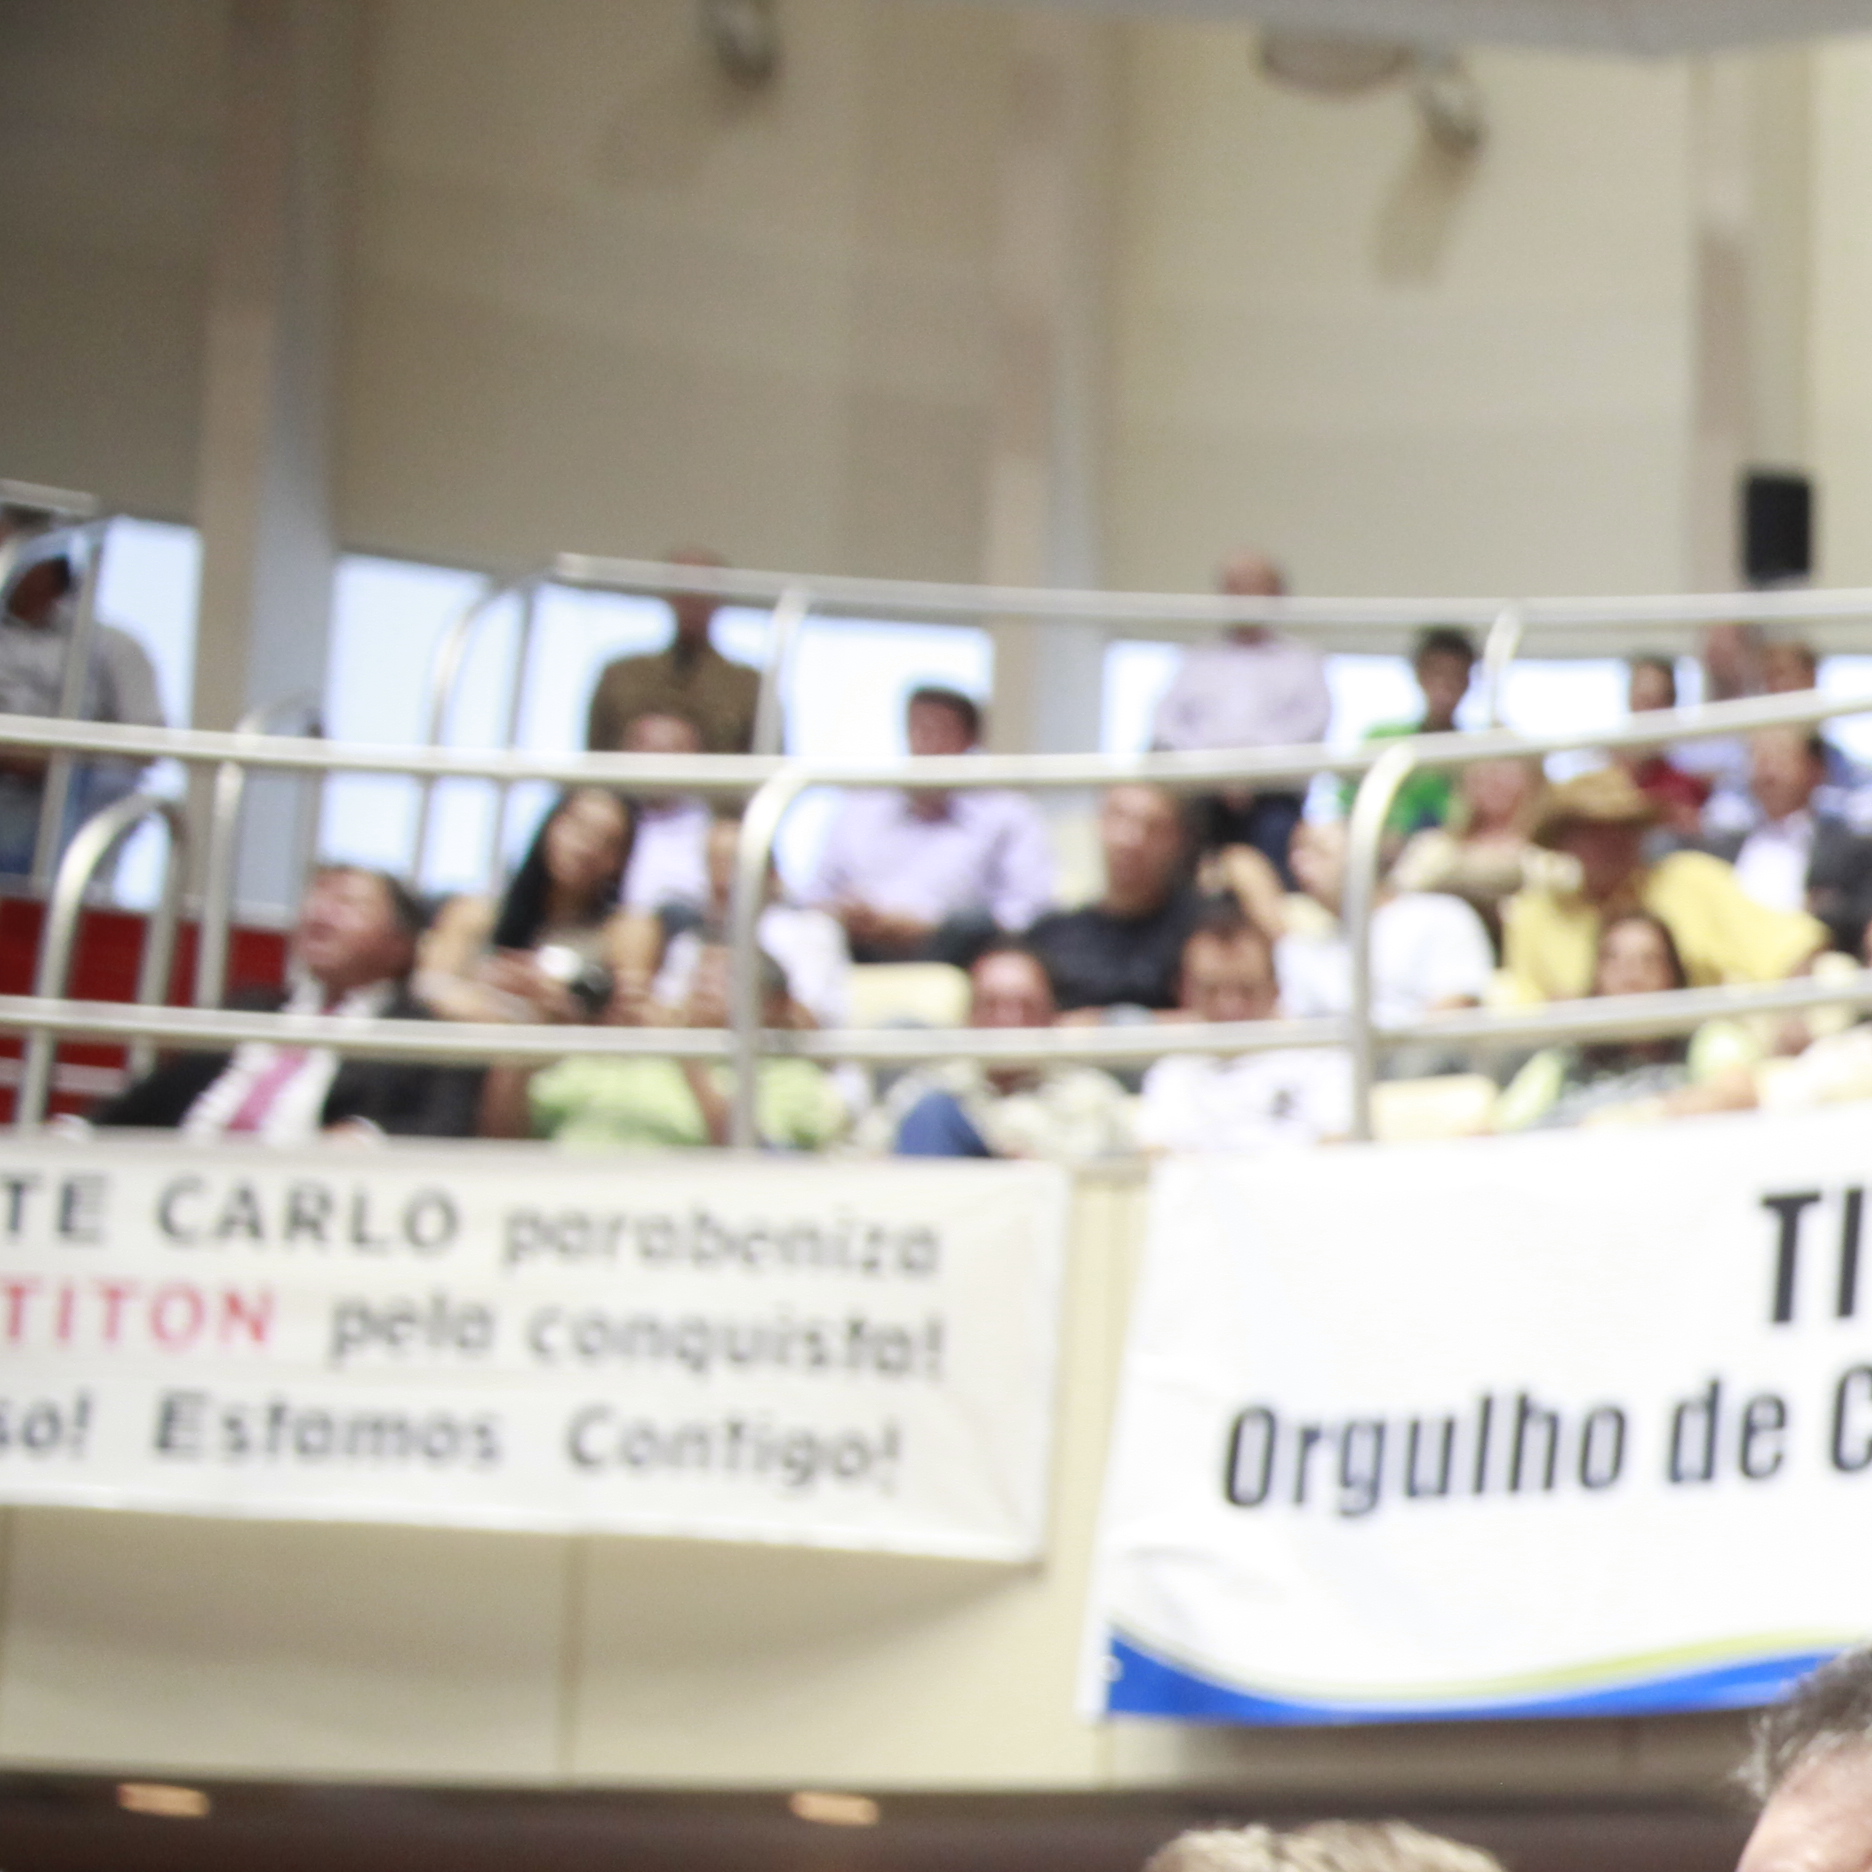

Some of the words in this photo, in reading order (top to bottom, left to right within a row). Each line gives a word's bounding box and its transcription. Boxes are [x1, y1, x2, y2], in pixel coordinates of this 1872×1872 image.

[155, 1174, 462, 1256] CARLO
[503, 1202, 942, 1278] parabeniza
[0, 1275, 278, 1354] TITON
[325, 1285, 495, 1374] pela
[525, 1303, 945, 1383] conquista!
[155, 1388, 502, 1469] Estamos
[565, 1402, 905, 1495] Contigo!
[1223, 1391, 1627, 1518] Orgulho
[1667, 1378, 1789, 1485] de
